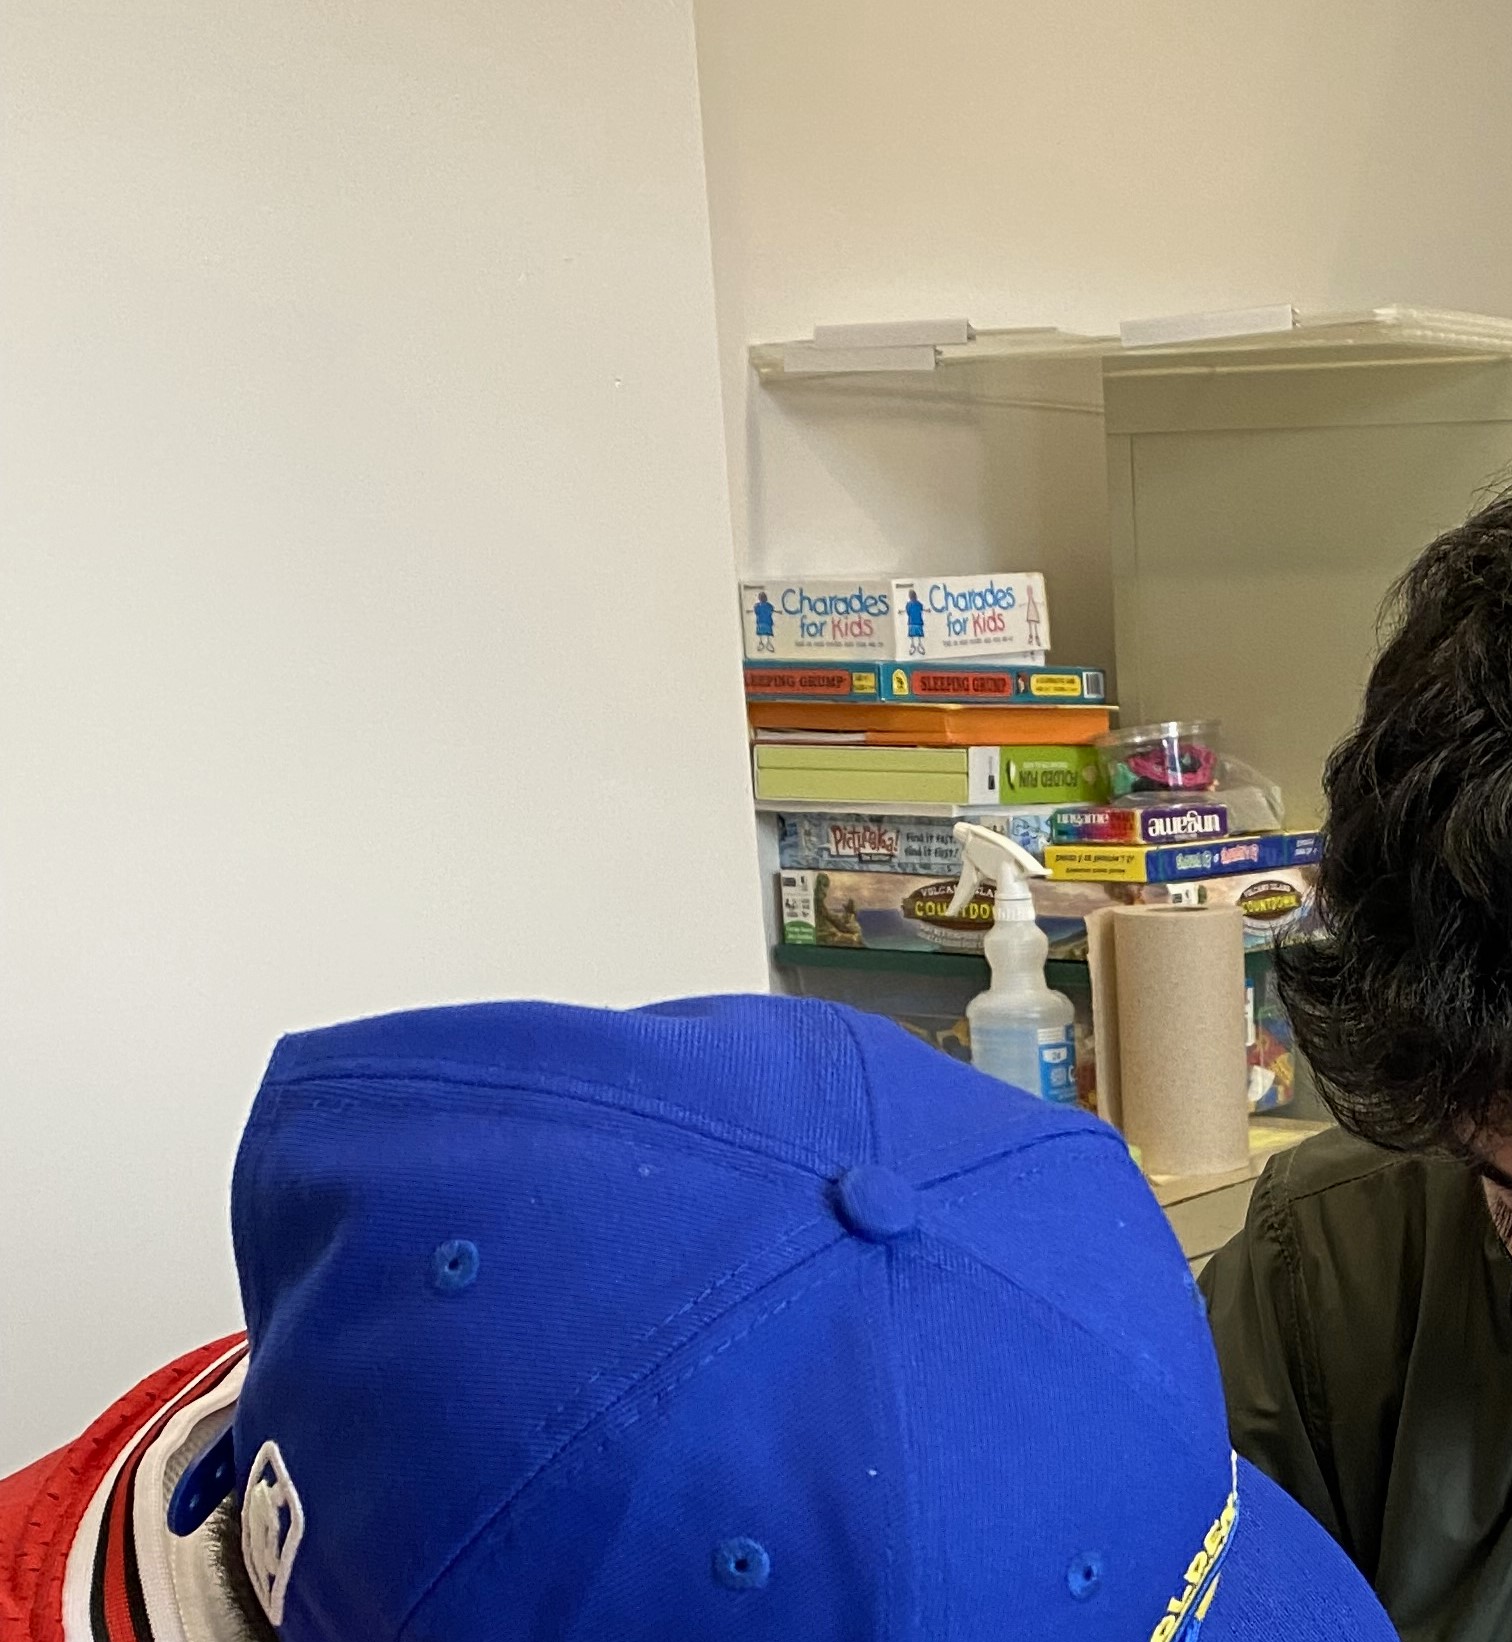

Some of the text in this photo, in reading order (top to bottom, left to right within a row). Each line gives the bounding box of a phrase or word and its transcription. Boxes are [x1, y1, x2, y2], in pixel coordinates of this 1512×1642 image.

[781, 586, 889, 617] Charades
[928, 580, 1016, 614] Charades
[799, 614, 875, 639] for Kids
[947, 608, 1006, 637] for Kids
[1040, 770, 1077, 788] FOLDED
[1148, 811, 1220, 836] ungame
